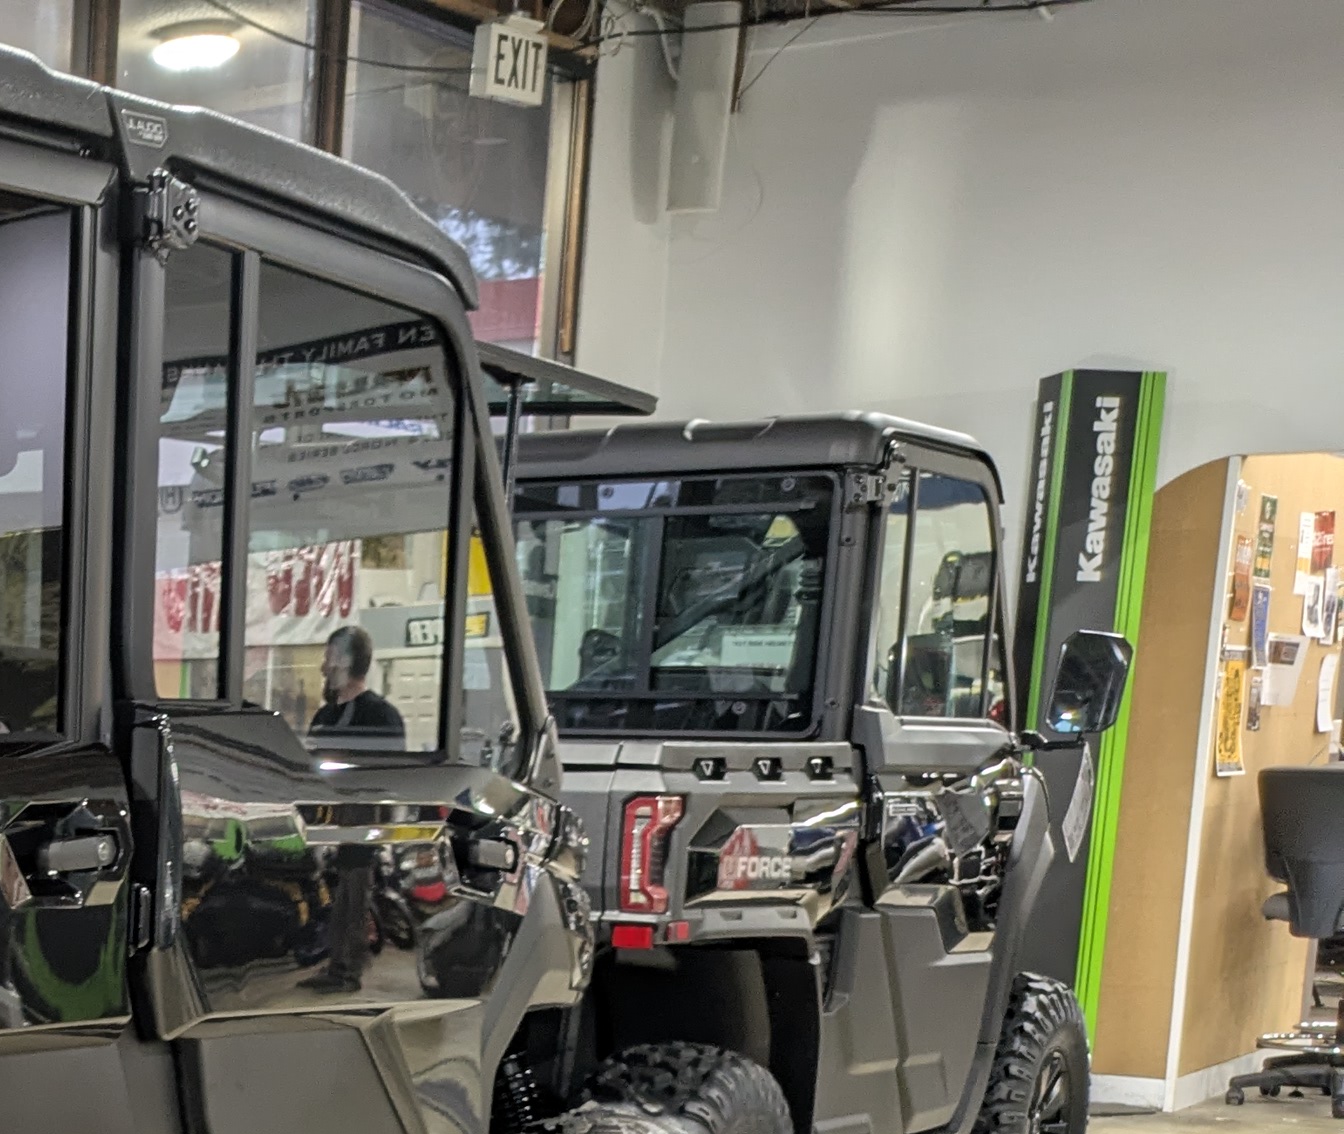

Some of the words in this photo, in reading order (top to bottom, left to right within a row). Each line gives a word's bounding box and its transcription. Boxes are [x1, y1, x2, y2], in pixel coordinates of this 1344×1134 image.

[493, 34, 544, 93] EXIT
[1025, 402, 1054, 583] Kawasaki
[1075, 396, 1122, 583] Kawasaki
